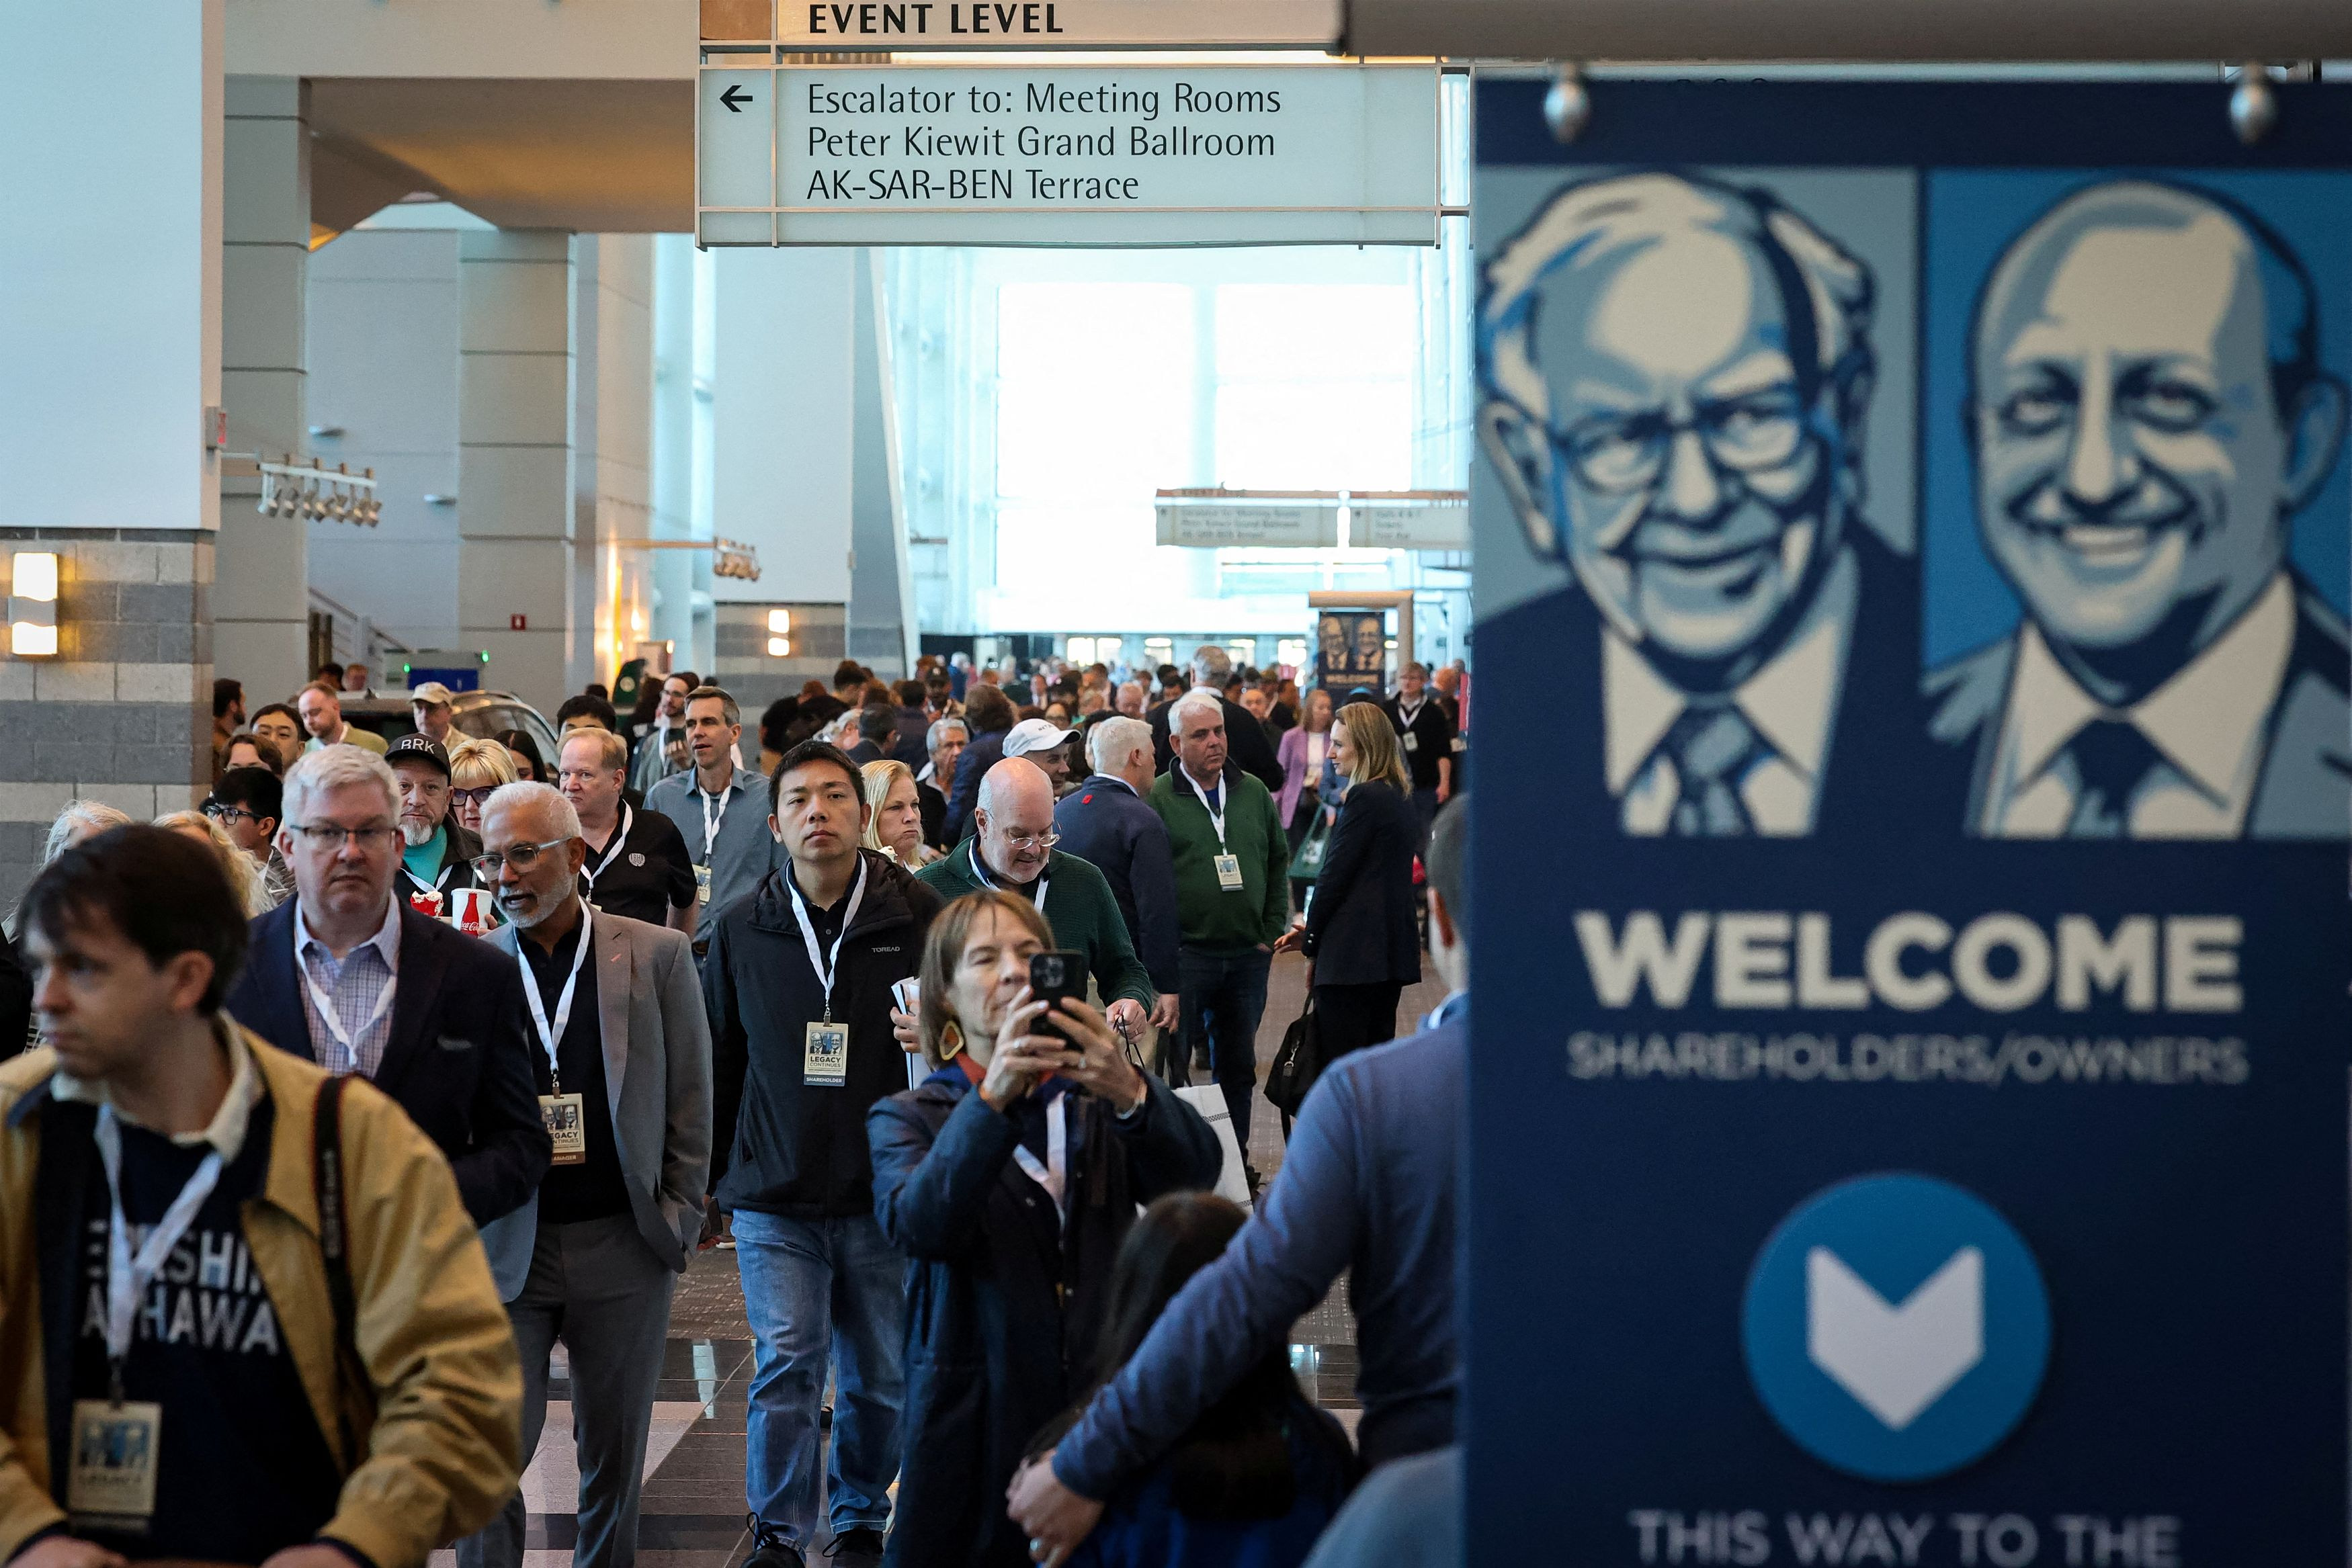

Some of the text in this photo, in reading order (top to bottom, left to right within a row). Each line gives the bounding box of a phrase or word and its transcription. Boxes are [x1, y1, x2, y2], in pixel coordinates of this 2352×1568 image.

[809, 3, 1063, 34] EVENT LEVEL
[809, 83, 1282, 122] Escalator to: Meeting Rooms
[809, 126, 1275, 157] Peter Kiewit Grand Ballroom
[807, 169, 1139, 200] AK-SAR-BEN Terrace
[401, 738, 435, 754] BRK
[1572, 910, 2243, 1012] WELCOME
[1567, 1030, 2249, 1087] SHAREHOLDERS/OWNERS
[1628, 1509, 2181, 1568] THIS WAY TO THE
